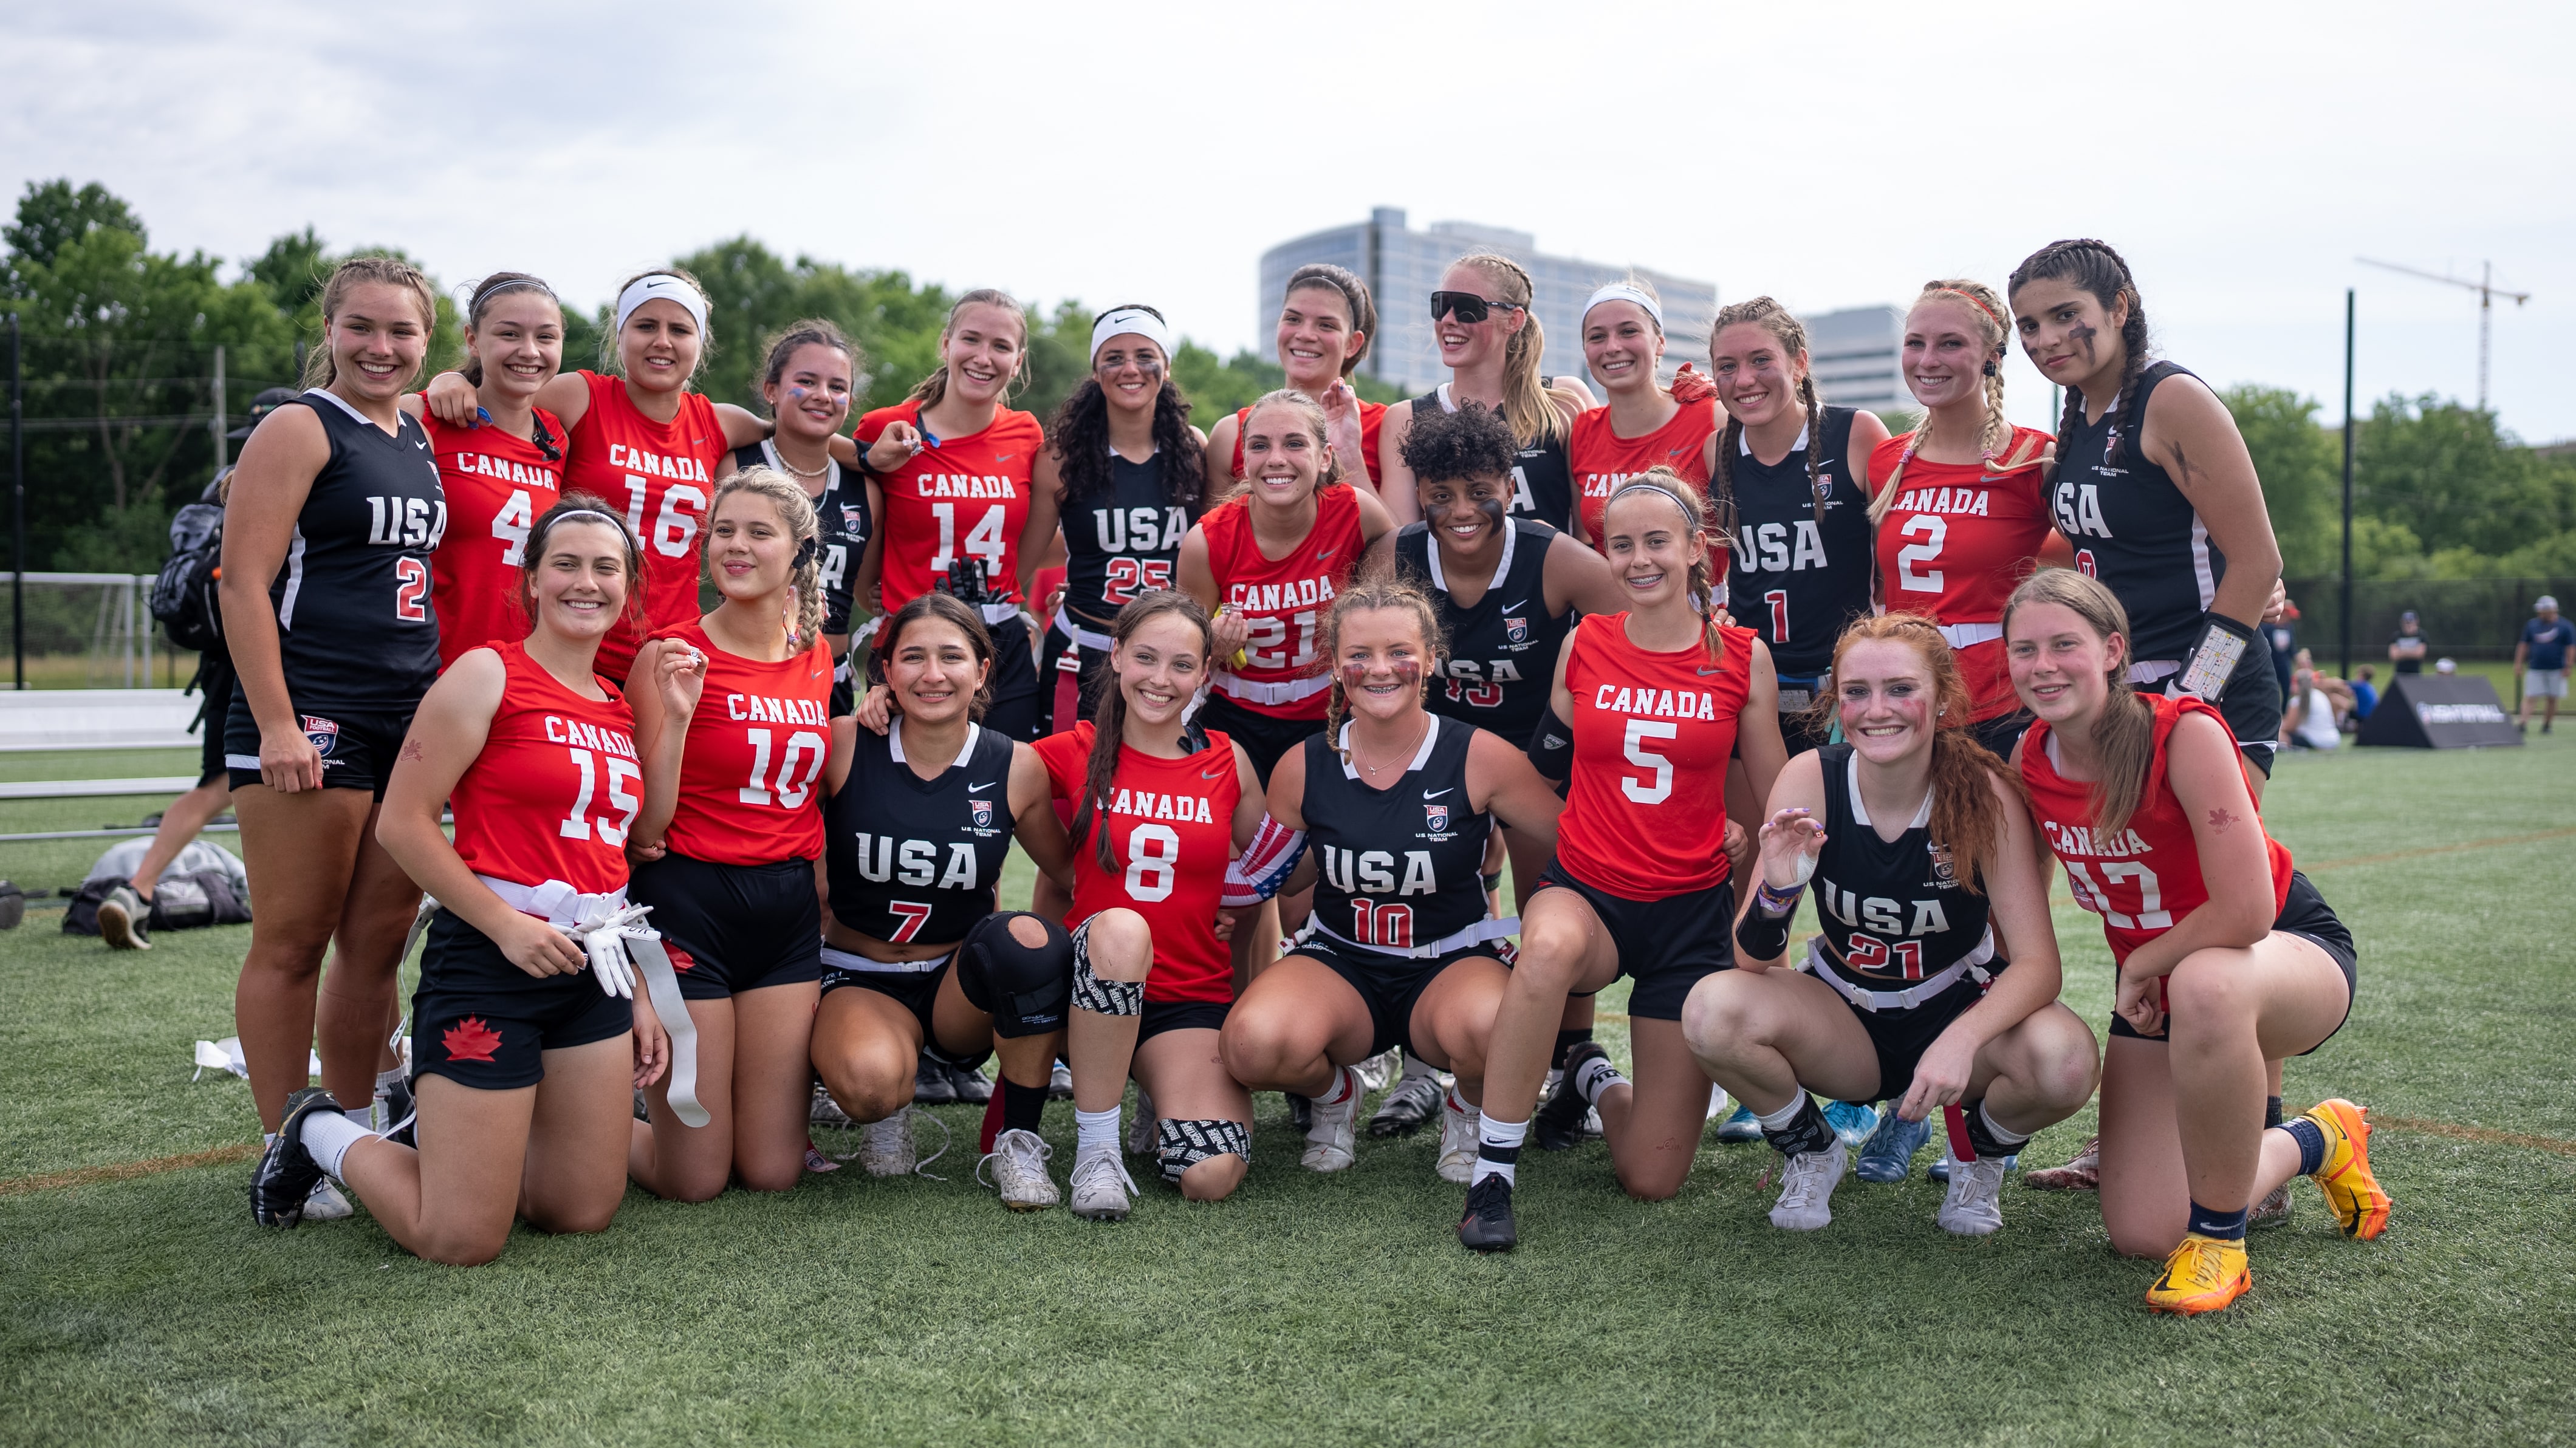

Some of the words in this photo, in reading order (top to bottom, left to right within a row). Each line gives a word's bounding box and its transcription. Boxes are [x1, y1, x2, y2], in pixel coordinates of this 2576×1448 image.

[457, 452, 555, 491] CANADA
[609, 443, 710, 483] CANADA
[917, 473, 1016, 499] CANADA
[1584, 473, 1640, 497] CAN
[366, 496, 447, 550] USA
[492, 489, 532, 567] 4
[625, 474, 706, 558] 16
[1092, 507, 1188, 553] USA
[2053, 482, 2113, 538] SA
[931, 502, 1005, 576] 14
[1726, 520, 1828, 573] USA
[1898, 514, 1948, 593] 2
[396, 556, 426, 622] 2
[1101, 557, 1171, 606] 25
[1230, 575, 1335, 611] CANADA
[1244, 610, 1318, 669] 21
[1764, 590, 1790, 644] 1
[1509, 639, 1539, 649] NATIONAL
[310, 719, 335, 728] USA
[727, 694, 827, 728] CANADA
[1595, 684, 1715, 721] CANADA
[544, 716, 640, 763] CANADA
[1621, 719, 1677, 805] 5
[739, 728, 826, 810] 10
[560, 748, 642, 848] 15
[855, 832, 977, 890] USA
[1125, 823, 1179, 903] 8
[1324, 845, 1436, 896] USA
[888, 900, 932, 942] 7
[1823, 876, 1950, 936] USA
[2066, 861, 2173, 930] 17
[1351, 898, 1413, 948] 10
[1846, 932, 1924, 979] 21
[1162, 1119, 1180, 1141] ROCKTAP
[1181, 1121, 1206, 1147] ROCKTAPE
